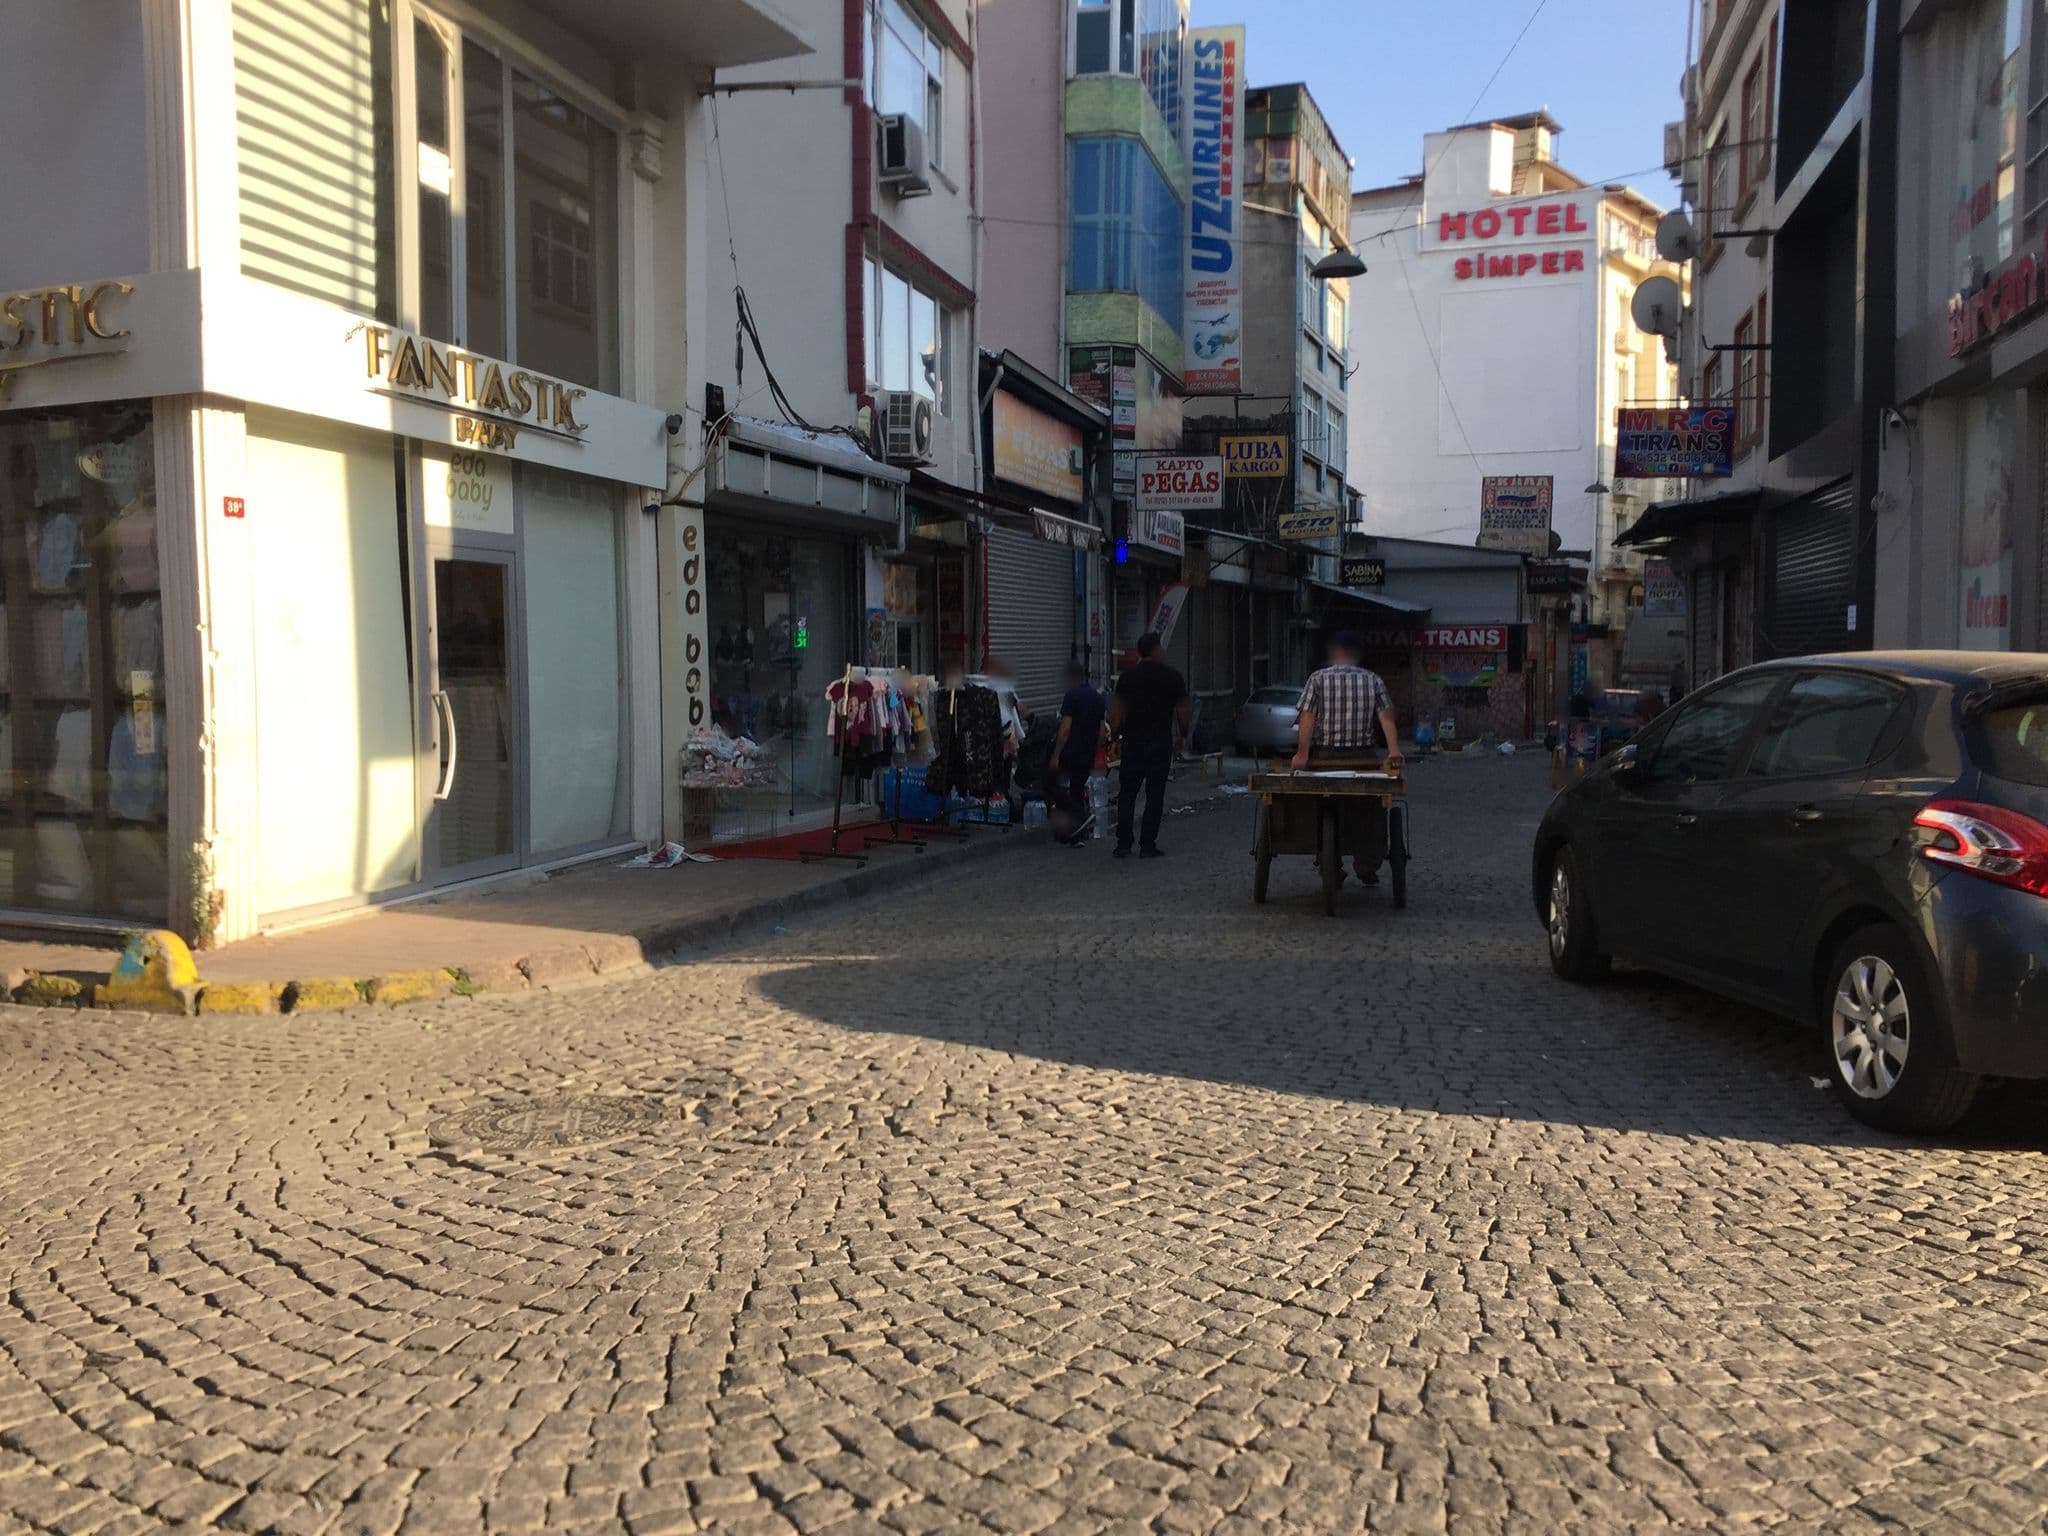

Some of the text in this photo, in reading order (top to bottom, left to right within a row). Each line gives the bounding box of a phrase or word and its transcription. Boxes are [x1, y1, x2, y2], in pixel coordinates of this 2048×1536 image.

[1223, 56, 1234, 183] EXPRESS
[1191, 39, 1233, 273] UZAIRLINES
[1440, 203, 1587, 241] HOTEL
[1455, 250, 1584, 280] SİMPER
[367, 327, 588, 434] FANTASTIC
[456, 416, 520, 450] BABY
[1625, 410, 1728, 432] M.R.C
[1225, 440, 1283, 460] LUBA
[1629, 432, 1723, 452] TRANS
[451, 451, 486, 478] eda
[1229, 461, 1280, 473] KARGO
[447, 473, 493, 512] baby
[1141, 472, 1220, 494] PEGAS
[1281, 516, 1336, 530] ESTO
[1424, 629, 1500, 646] TRANS
[685, 633, 704, 732] bab
